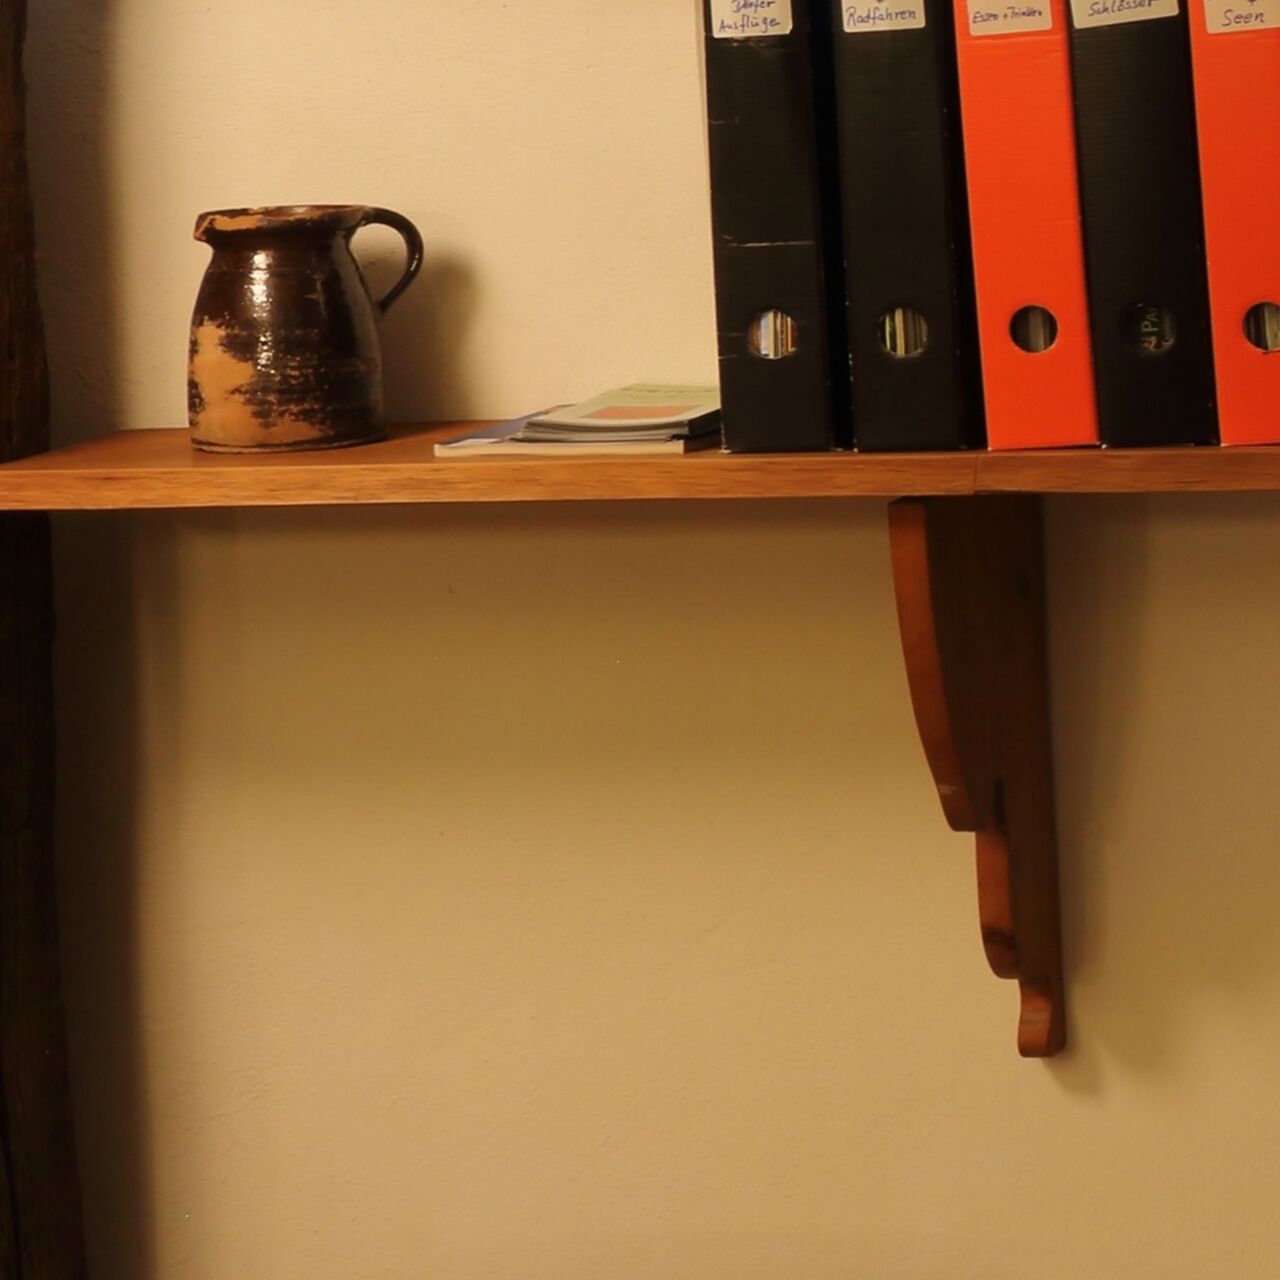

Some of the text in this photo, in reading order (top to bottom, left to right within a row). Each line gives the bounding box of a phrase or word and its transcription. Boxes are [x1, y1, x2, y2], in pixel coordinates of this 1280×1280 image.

[719, 14, 780, 32] Ausflüge
[845, 7, 916, 26] Radfahren
[1222, 8, 1265, 27] Seen
